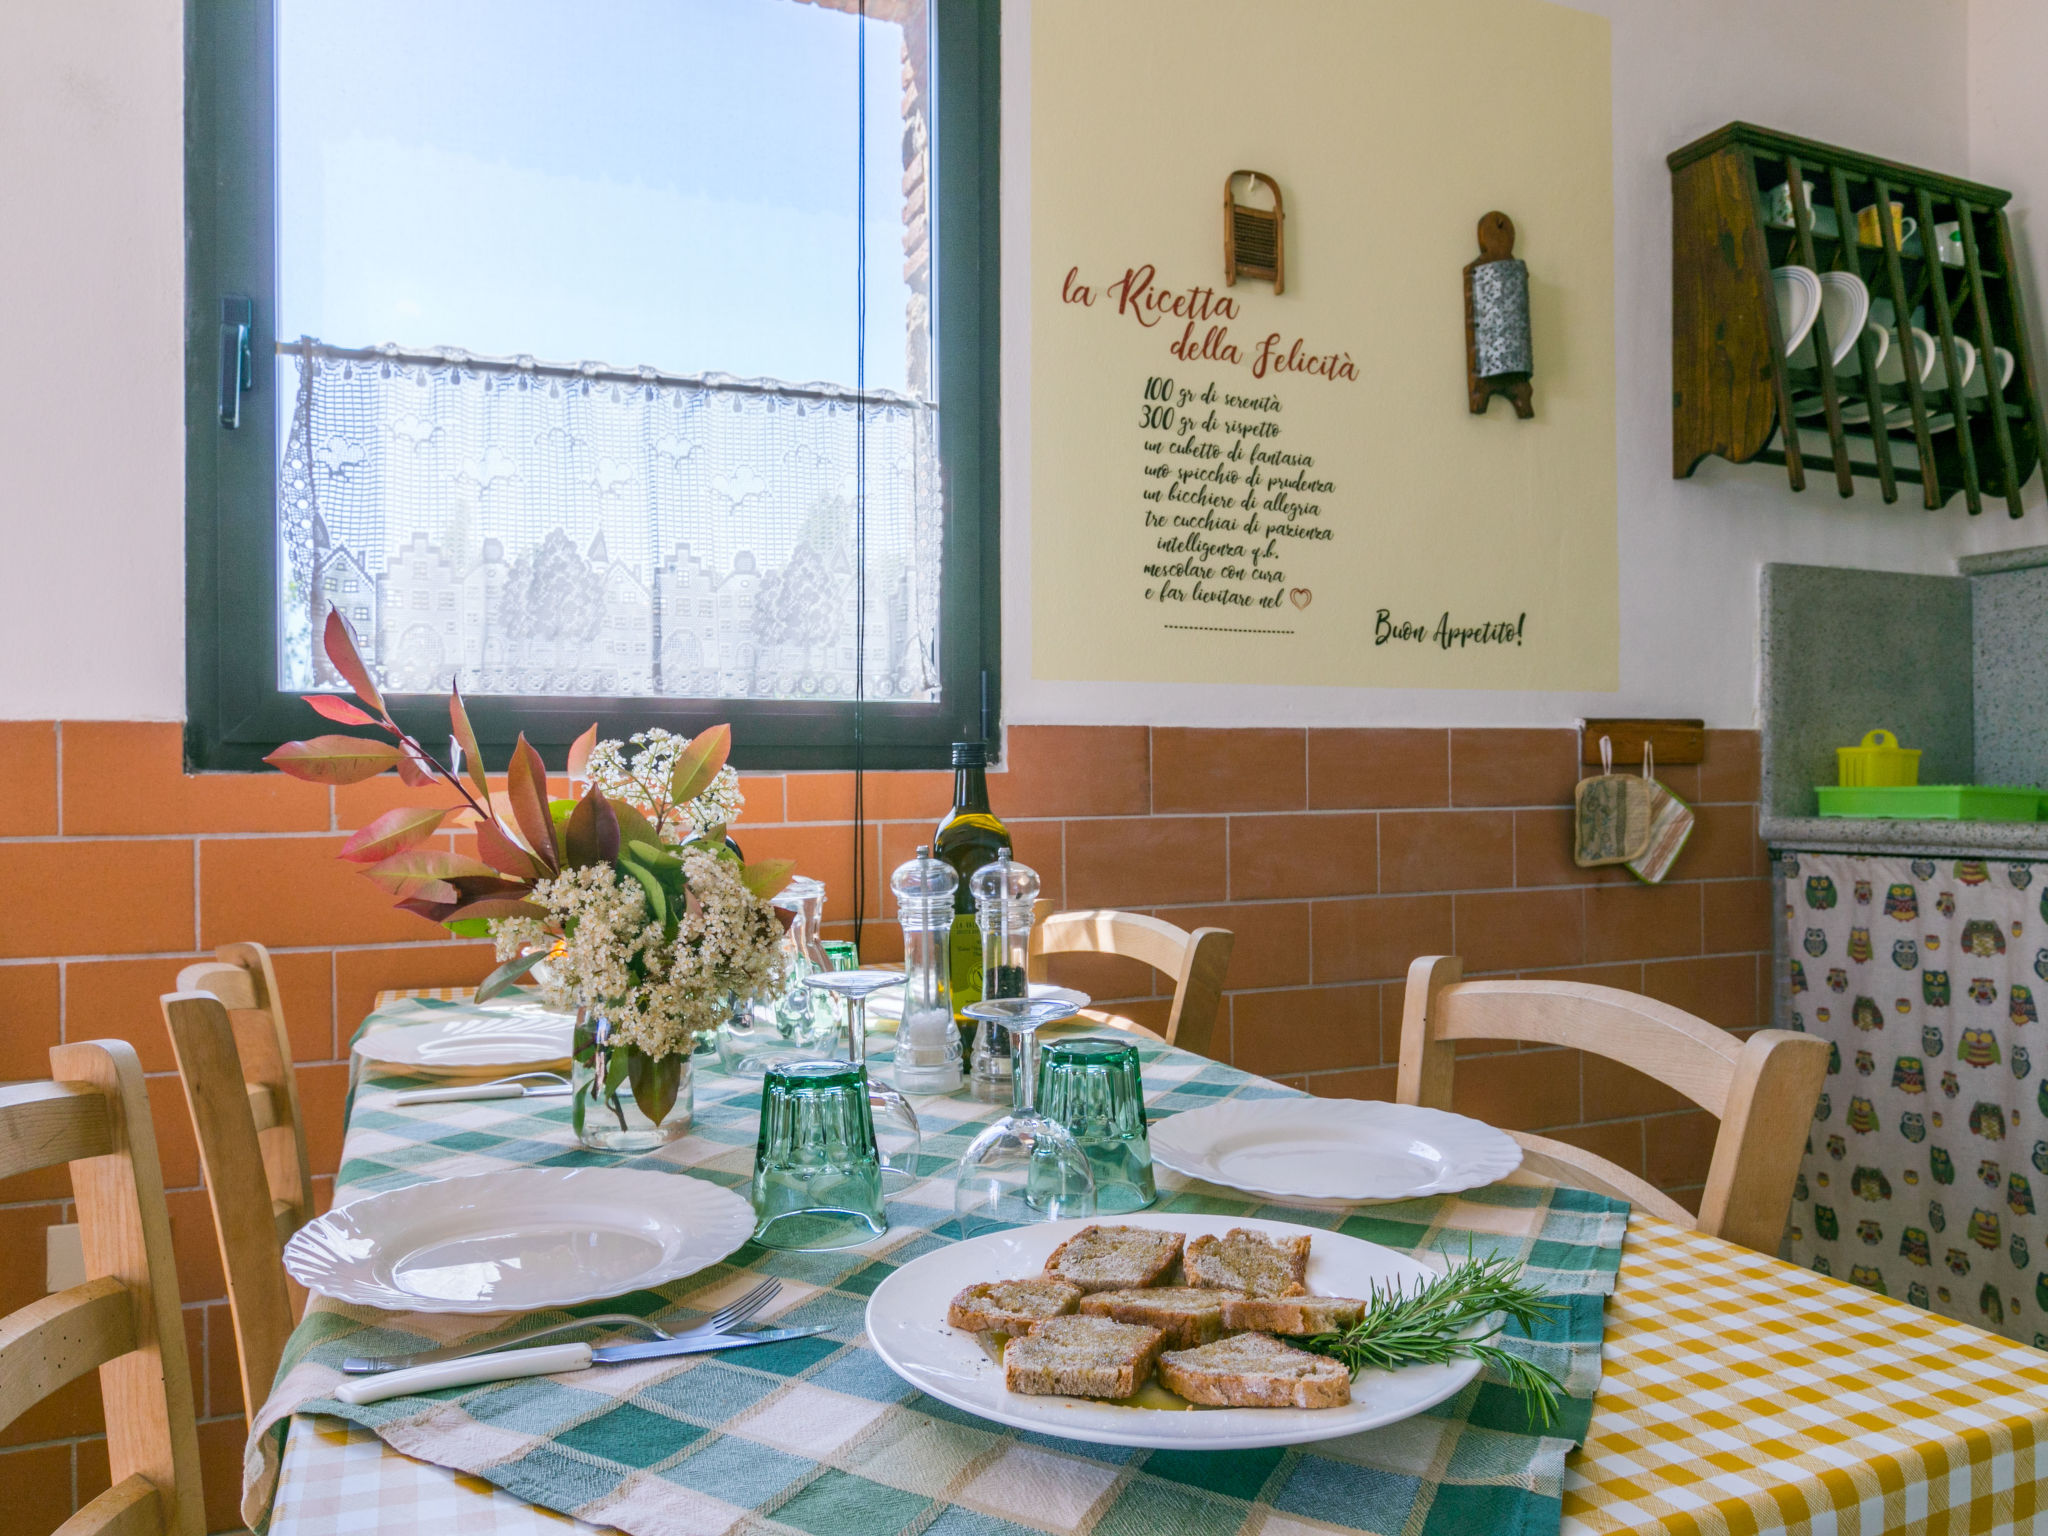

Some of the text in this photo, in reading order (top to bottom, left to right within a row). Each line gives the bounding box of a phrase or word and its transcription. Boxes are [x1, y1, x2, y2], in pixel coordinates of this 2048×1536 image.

[1062, 264, 1239, 327] la Ricetta
[1170, 321, 1360, 381] della Felicità
[1144, 377, 1283, 412] 100 gr di serenità
[1139, 404, 1282, 438] 300 gr di rispetto
[1144, 435, 1315, 467] un cubetto di fantasia
[1144, 462, 1336, 493] uno spicchio di prudenza
[1143, 483, 1321, 521] un bicchiere di allegria
[1145, 509, 1335, 541] tre cucchiai di pazienza
[1157, 532, 1279, 566] intelligenza q.b.
[1144, 557, 1286, 583] mescolare con cura
[1144, 580, 1285, 609] e far lievitare nel
[1375, 608, 1526, 650] Buon Appetito!
